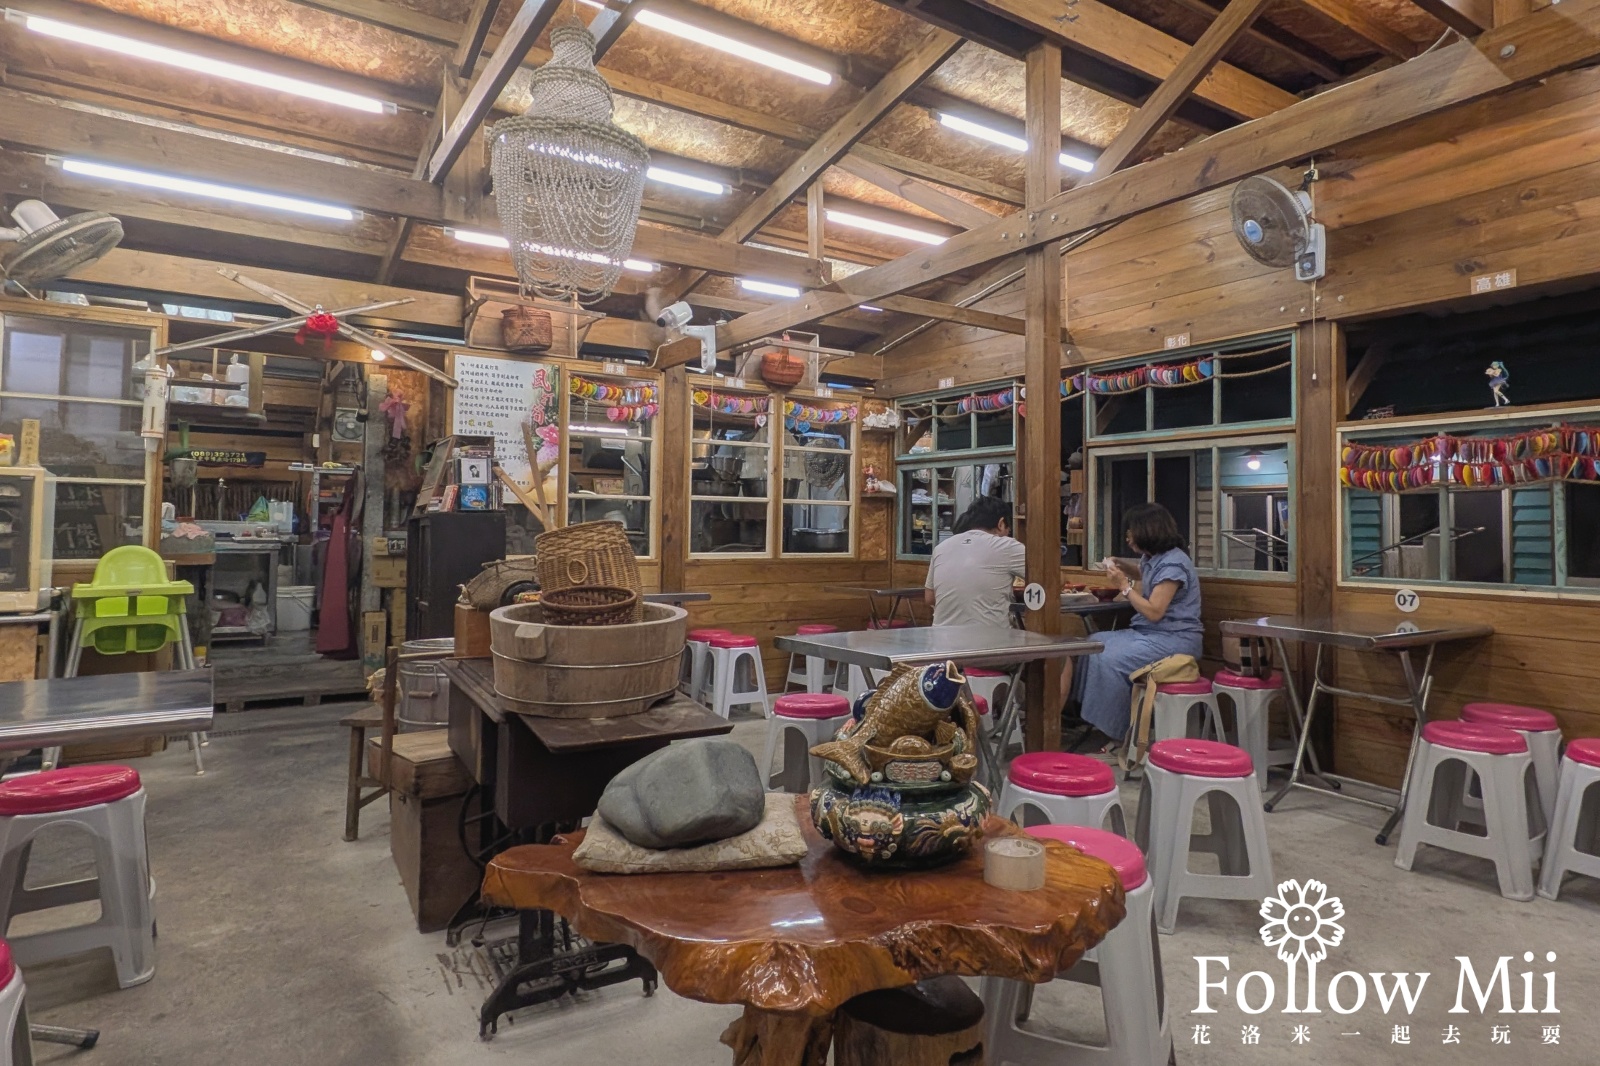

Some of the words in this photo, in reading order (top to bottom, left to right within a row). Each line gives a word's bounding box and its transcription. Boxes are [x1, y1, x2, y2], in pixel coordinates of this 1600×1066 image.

[1476, 273, 1511, 292] 高雄
[1167, 335, 1187, 348] 彰化
[605, 363, 625, 375] 屏東
[1026, 588, 1041, 604] 11
[1397, 594, 1417, 606] 07
